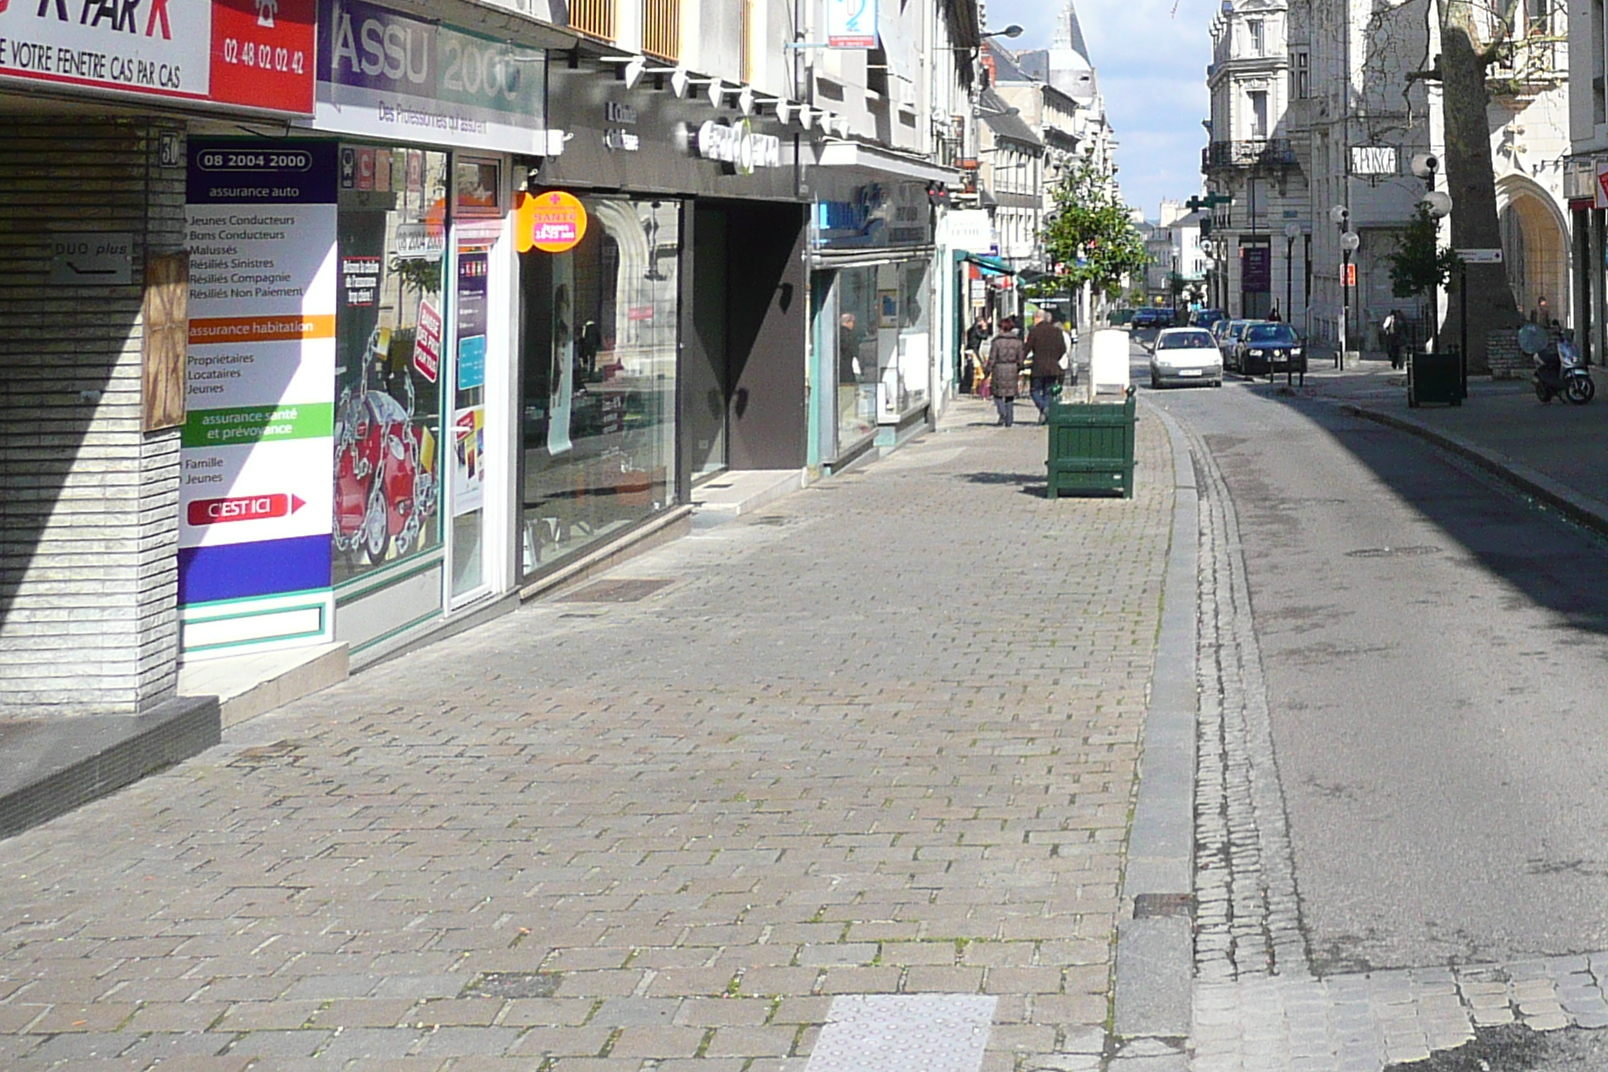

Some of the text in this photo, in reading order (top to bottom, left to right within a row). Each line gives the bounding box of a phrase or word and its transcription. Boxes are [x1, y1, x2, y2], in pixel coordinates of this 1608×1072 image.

[332, 13, 429, 84] ASSU
[224, 38, 304, 74] 02 48 02 02 42
[11, 41, 52, 71] VOTRE
[57, 48, 106, 78] FENETRE
[110, 56, 133, 83] CAS
[138, 60, 155, 85] PAR
[159, 64, 180, 89] CAS
[378, 100, 395, 122] Des
[162, 136, 178, 163] 30
[204, 155, 305, 167] 08 2004 2000
[209, 187, 299, 197] assurance auto
[190, 215, 295, 226] Jeunes Conducteurs
[190, 229, 285, 241] Bons Conducteurs
[56, 242, 128, 257] DUO plus
[190, 257, 274, 269] Résiliés Sinistres
[190, 272, 291, 286] Résiliés Compagnie
[190, 286, 303, 299] Résiliés Non Paiement
[189, 321, 314, 337] assurance habitation
[187, 353, 254, 367] Propriétaires
[187, 368, 241, 380] Locataires
[187, 384, 224, 395] Jeunes
[202, 407, 298, 425] assurance santé
[207, 422, 293, 440] et prévoyance
[185, 457, 223, 469] Famille
[185, 473, 223, 485] Jeunes
[208, 498, 270, 518] C'EST ICI
